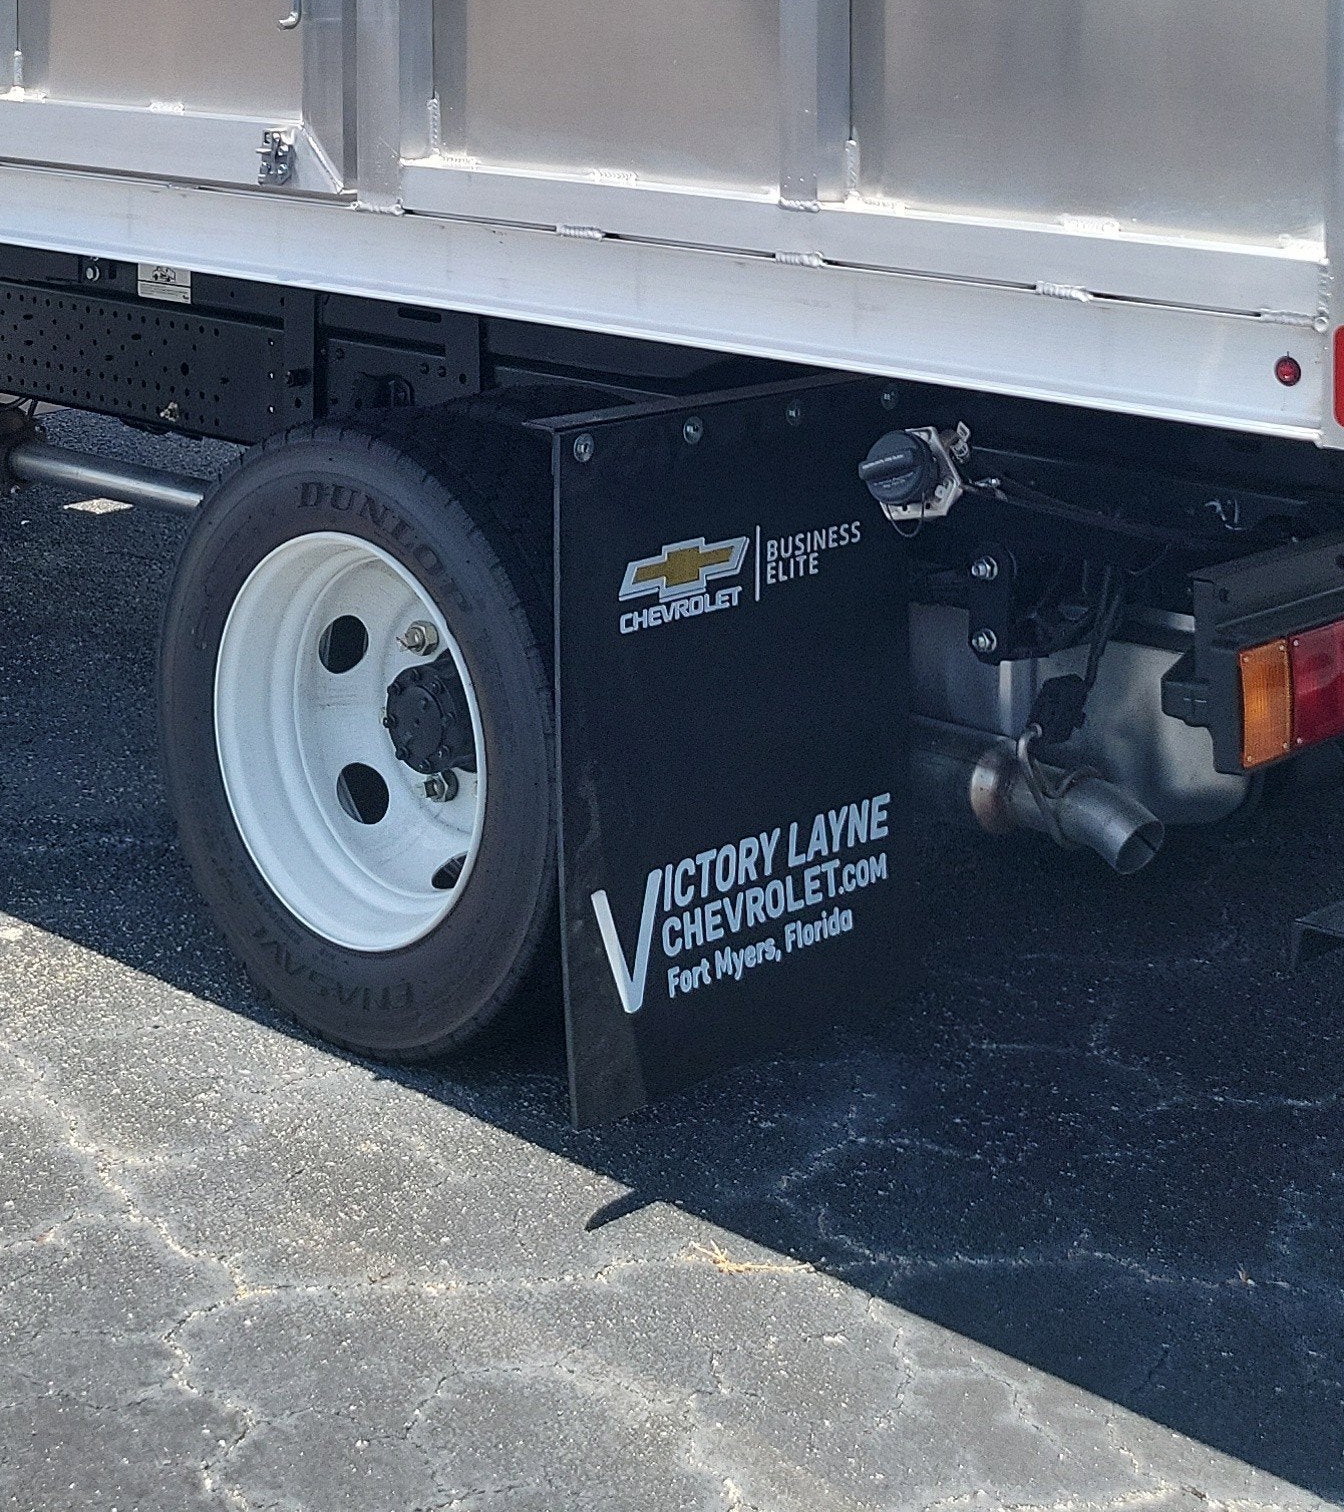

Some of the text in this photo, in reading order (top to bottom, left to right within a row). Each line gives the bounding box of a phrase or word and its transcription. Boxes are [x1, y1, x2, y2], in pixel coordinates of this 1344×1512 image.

[298, 482, 473, 614] DUNLOP
[767, 521, 861, 563] BUSINESS
[767, 553, 819, 585] ELITE
[619, 586, 742, 634] CHEVROLET
[590, 792, 891, 1014] VICTORY LAYNE
[662, 852, 887, 958] CHEVROLET.COM
[667, 907, 853, 999] Fort Myers, Florida
